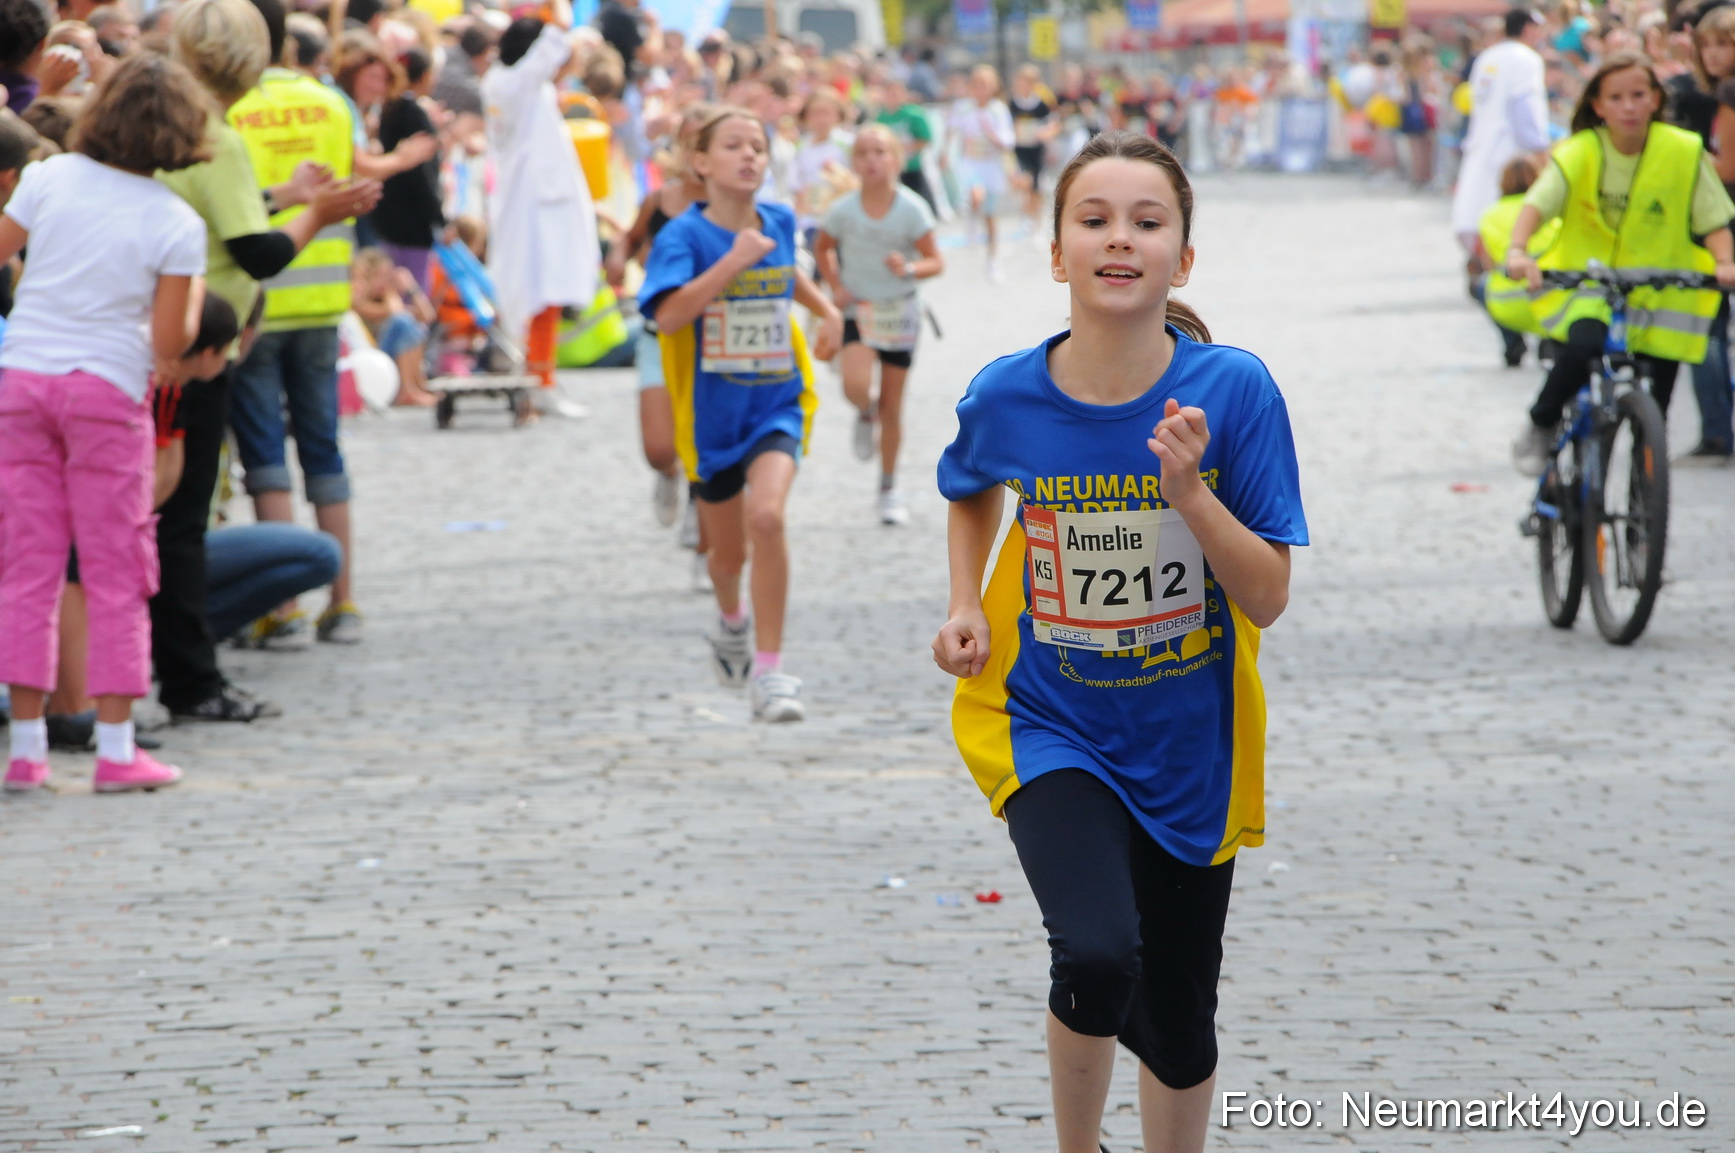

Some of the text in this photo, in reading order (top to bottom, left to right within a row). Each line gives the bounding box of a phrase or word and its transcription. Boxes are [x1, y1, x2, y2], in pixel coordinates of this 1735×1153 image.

[731, 323, 785, 346] 7213
[1066, 525, 1143, 551] Amelie
[1034, 558, 1053, 581] K5
[1072, 561, 1188, 606] 7212
[1050, 627, 1092, 642] BOCK
[1138, 612, 1202, 637] PFLEIDERER
[1084, 650, 1224, 688] www.stadtlauf-neumarkt.de
